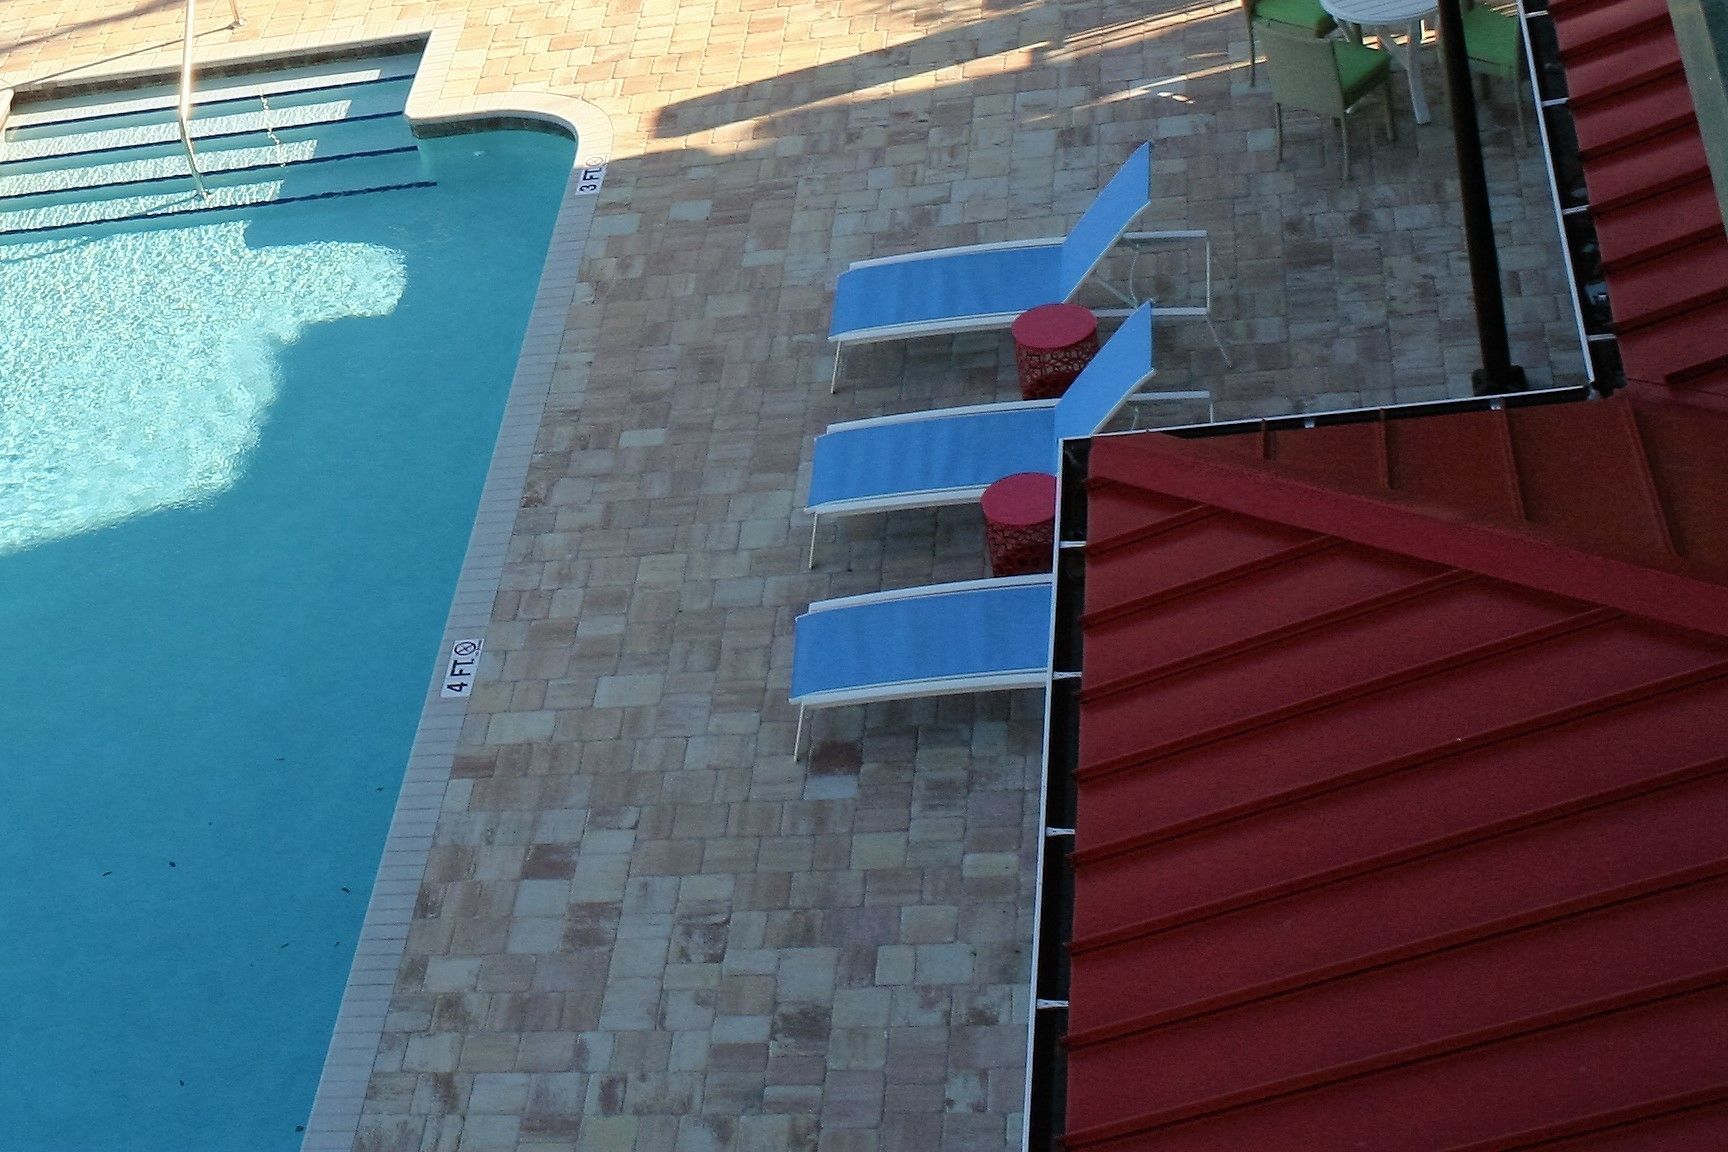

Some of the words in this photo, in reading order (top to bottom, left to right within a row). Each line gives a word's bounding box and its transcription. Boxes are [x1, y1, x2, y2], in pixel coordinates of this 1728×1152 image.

[582, 167, 602, 181] FT
[579, 184, 598, 192] 3
[450, 659, 475, 676] FT
[446, 681, 468, 692] 4
